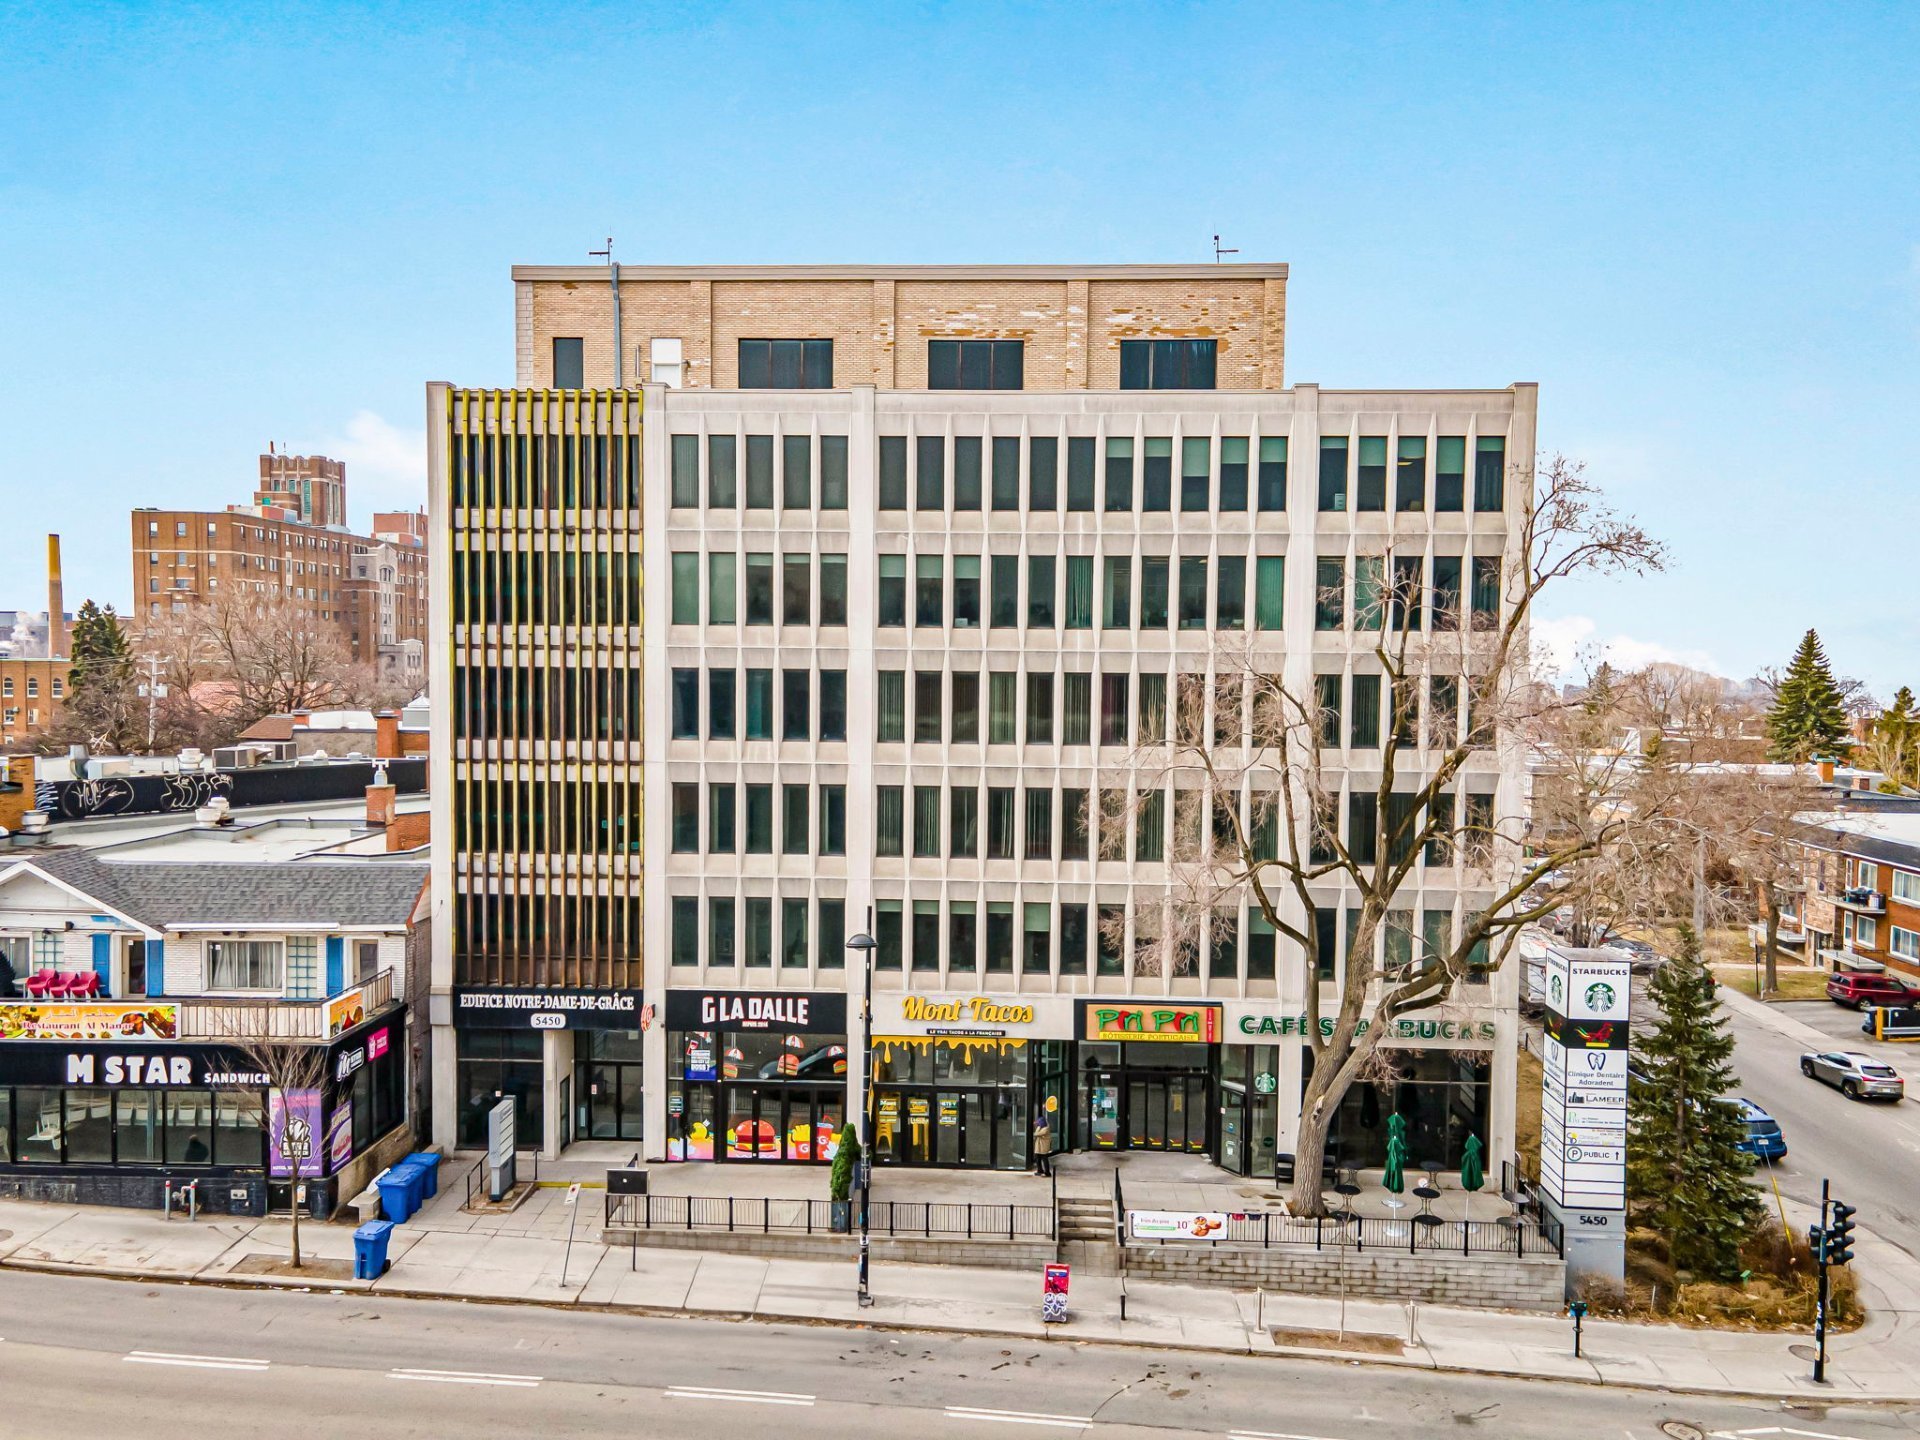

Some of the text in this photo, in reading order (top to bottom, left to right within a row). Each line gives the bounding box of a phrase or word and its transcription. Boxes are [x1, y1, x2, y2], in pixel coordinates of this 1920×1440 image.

[1572, 968, 1628, 976] STARBUCKS
[460, 992, 634, 1011] EDIFICE NOTRE-DAME-DE-GRÂCE
[702, 996, 809, 1026] G LA DALLE
[902, 995, 1033, 1023] Mont Tacos
[22, 1021, 80, 1030] Restaurant
[535, 1016, 561, 1026] 5450
[67, 1053, 192, 1084] M STAR
[203, 1072, 270, 1084] SANDWICH
[1568, 1071, 1594, 1079] Clinique
[1586, 1095, 1624, 1103] LAMEER
[1176, 1220, 1188, 1230] 10
[1579, 1216, 1608, 1226] 5450
